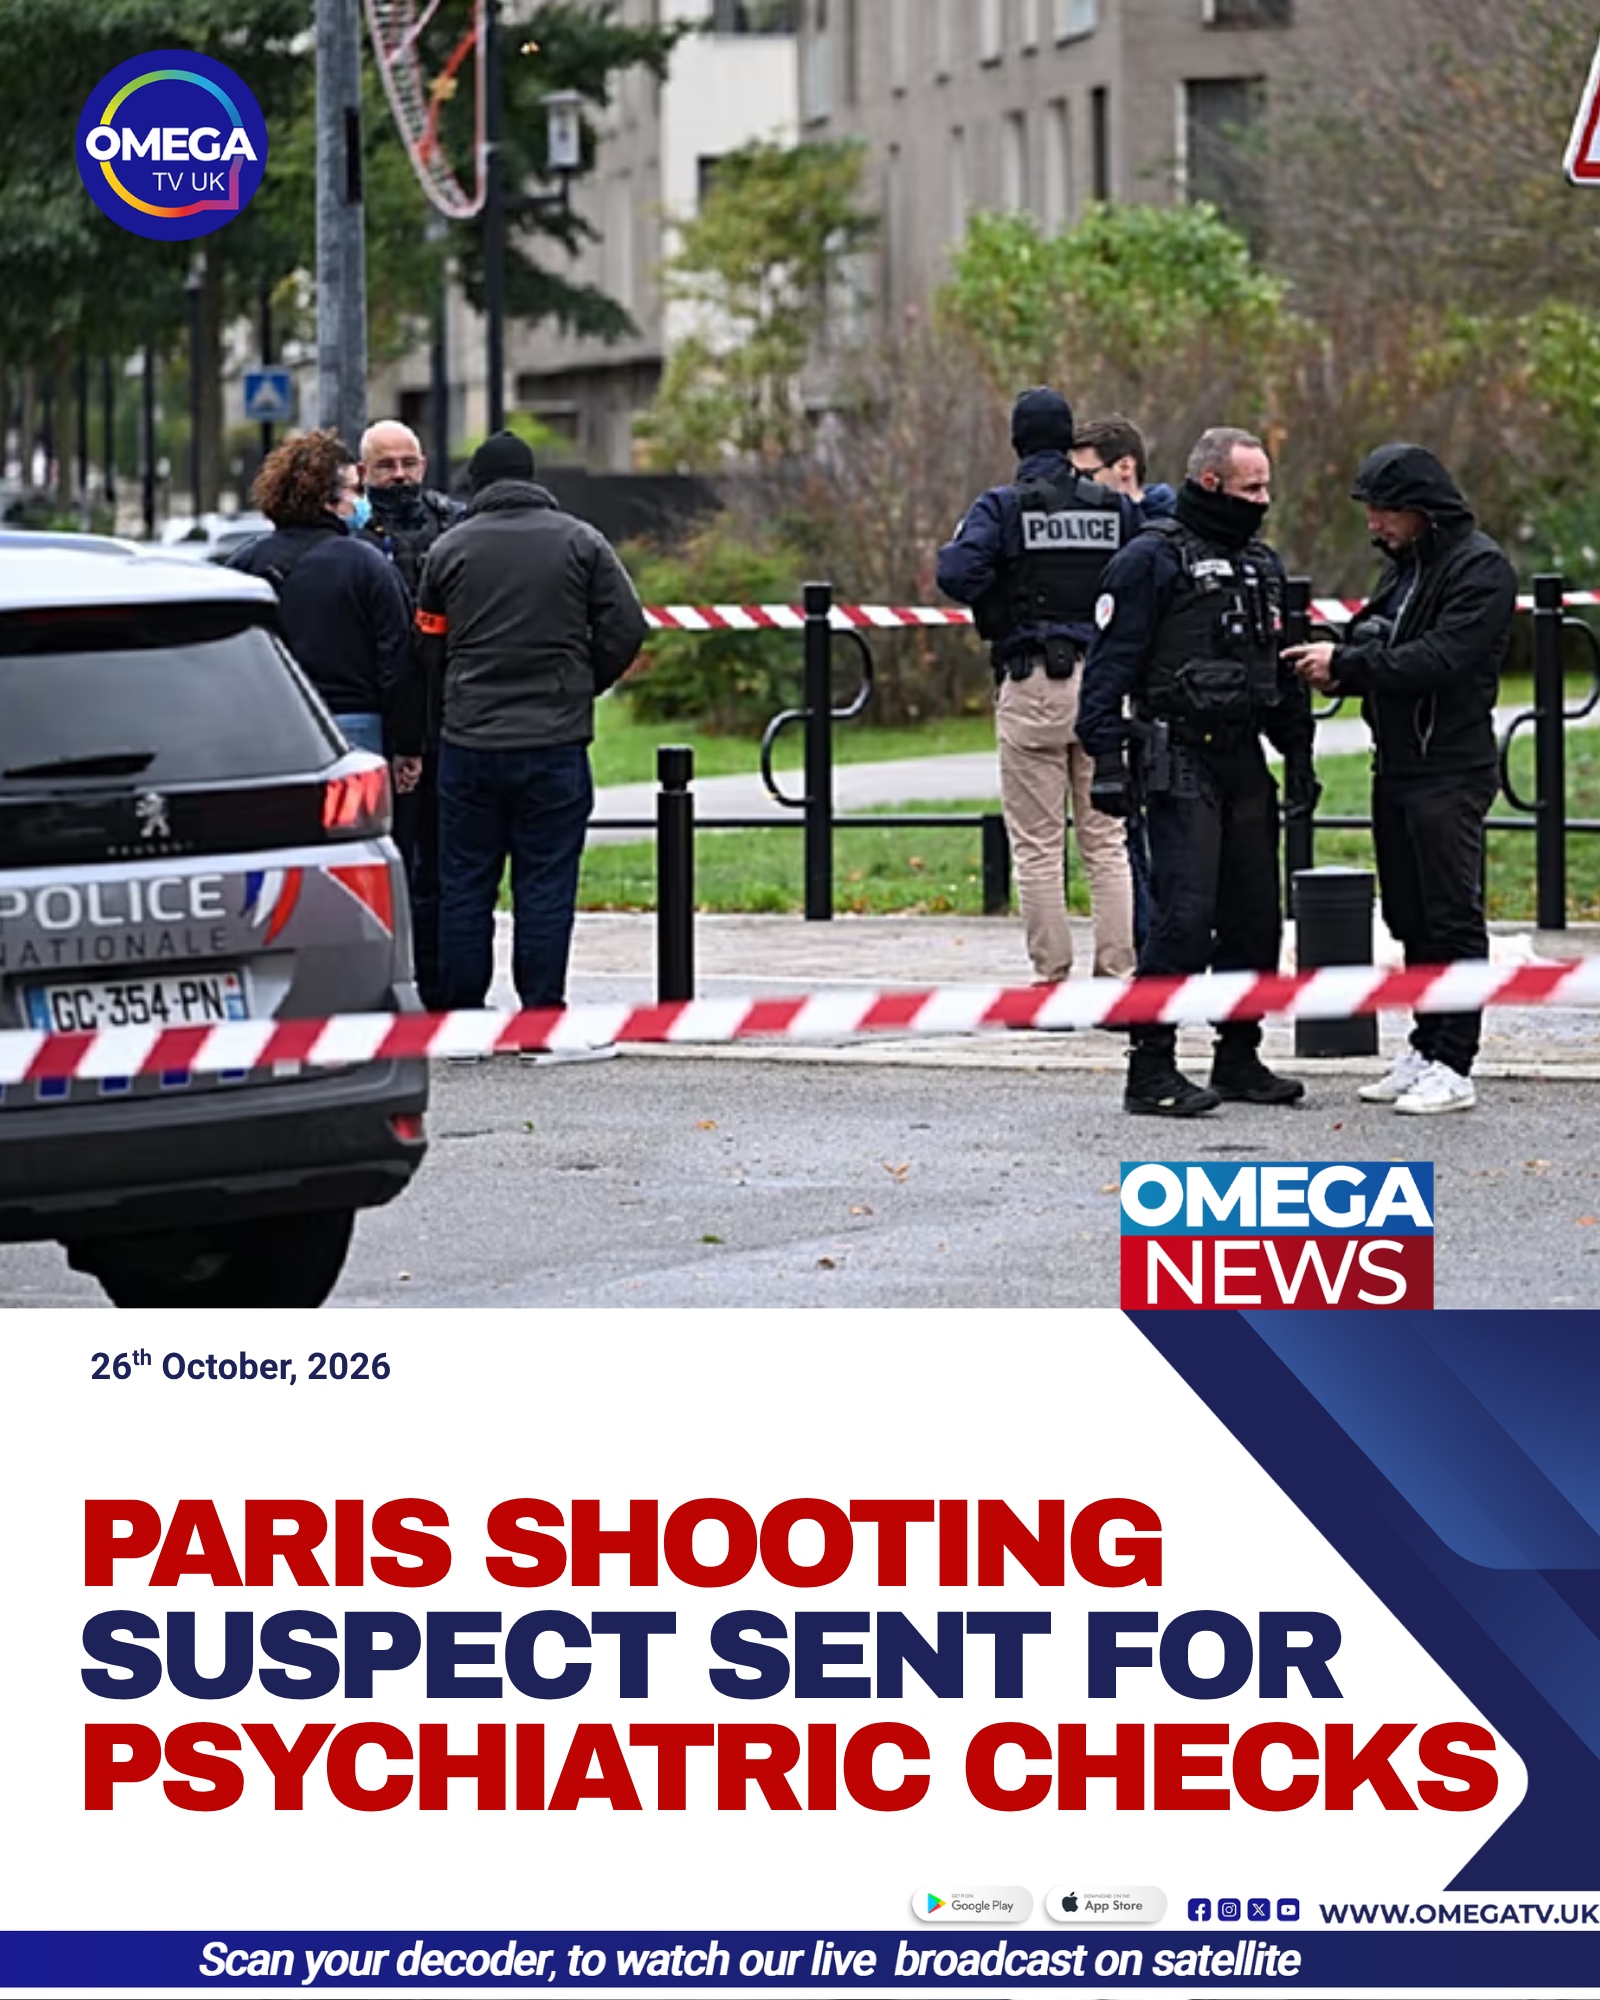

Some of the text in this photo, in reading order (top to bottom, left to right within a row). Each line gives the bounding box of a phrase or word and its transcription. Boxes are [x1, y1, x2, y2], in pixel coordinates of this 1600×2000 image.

[1027, 518, 1116, 542] POLICE
[0, 873, 226, 931] POLICE
[0, 926, 226, 968] ATIONALE
